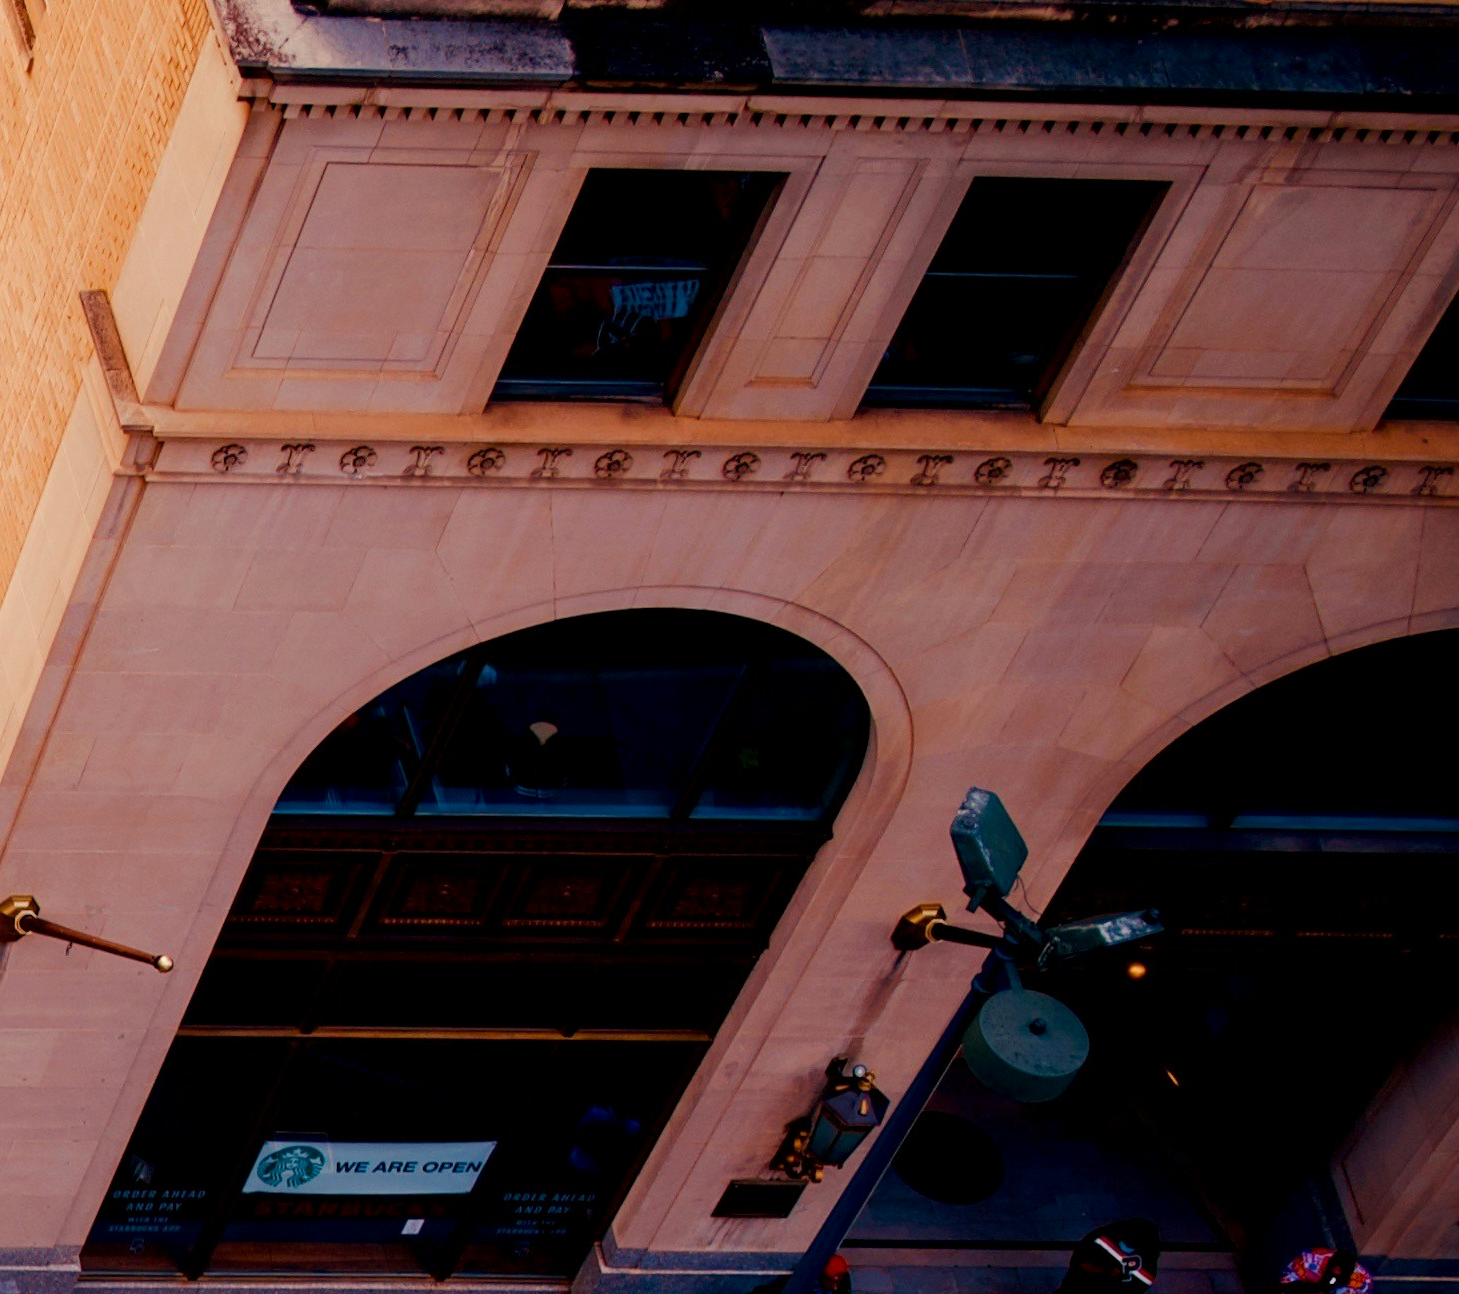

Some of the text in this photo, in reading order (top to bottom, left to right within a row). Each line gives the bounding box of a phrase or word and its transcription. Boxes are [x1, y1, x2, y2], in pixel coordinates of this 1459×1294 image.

[336, 1161, 482, 1173] WE ARE OPEN
[125, 1201, 182, 1212] AND PAY
